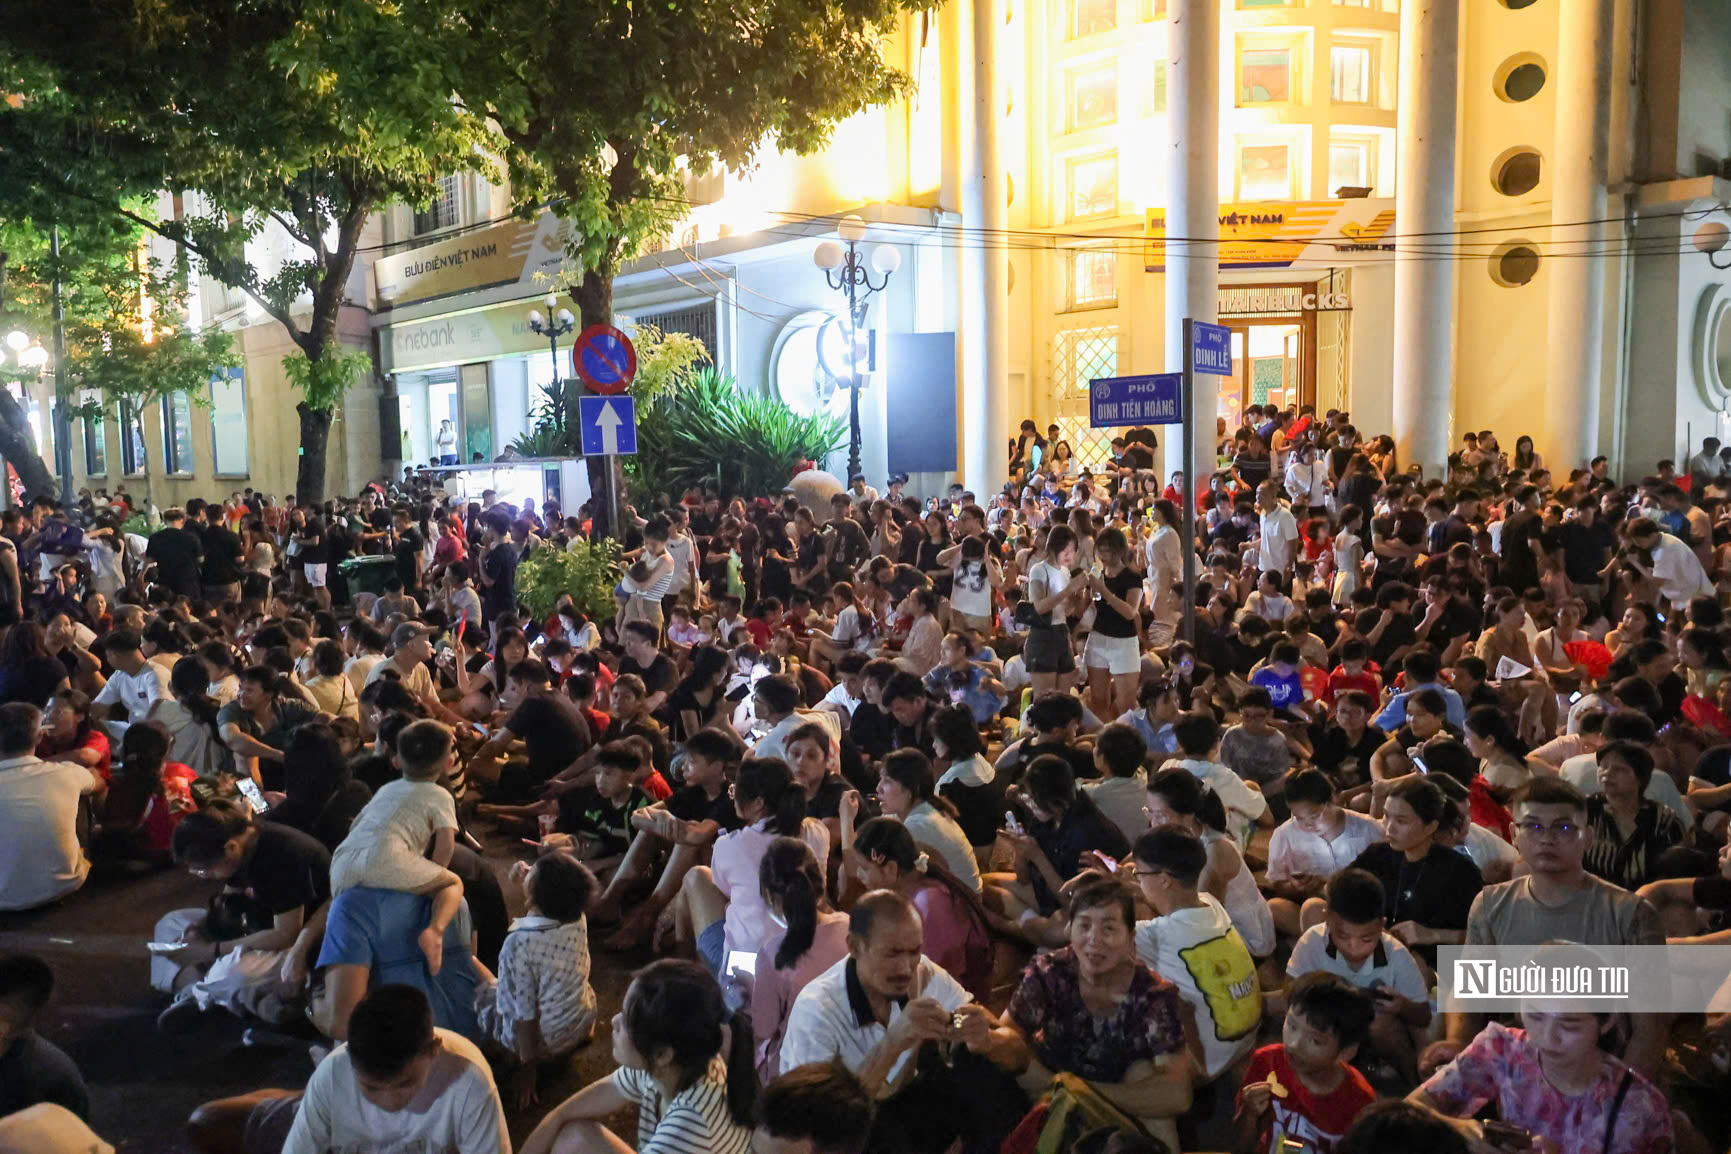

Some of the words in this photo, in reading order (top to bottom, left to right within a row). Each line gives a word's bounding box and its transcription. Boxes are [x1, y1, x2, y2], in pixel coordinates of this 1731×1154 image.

[1218, 211, 1248, 233] VIỆT
[1250, 213, 1283, 225] NAM
[404, 261, 424, 278] BƯU
[425, 256, 448, 275] ĐIỆN
[447, 250, 470, 269] VIỆT
[471, 243, 497, 260] NAM
[1217, 293, 1349, 313] TARBUCKS
[1128, 381, 1156, 394] PHỐ
[1121, 398, 1141, 418] TIÊN
[1144, 397, 1175, 417] HOÀNG
